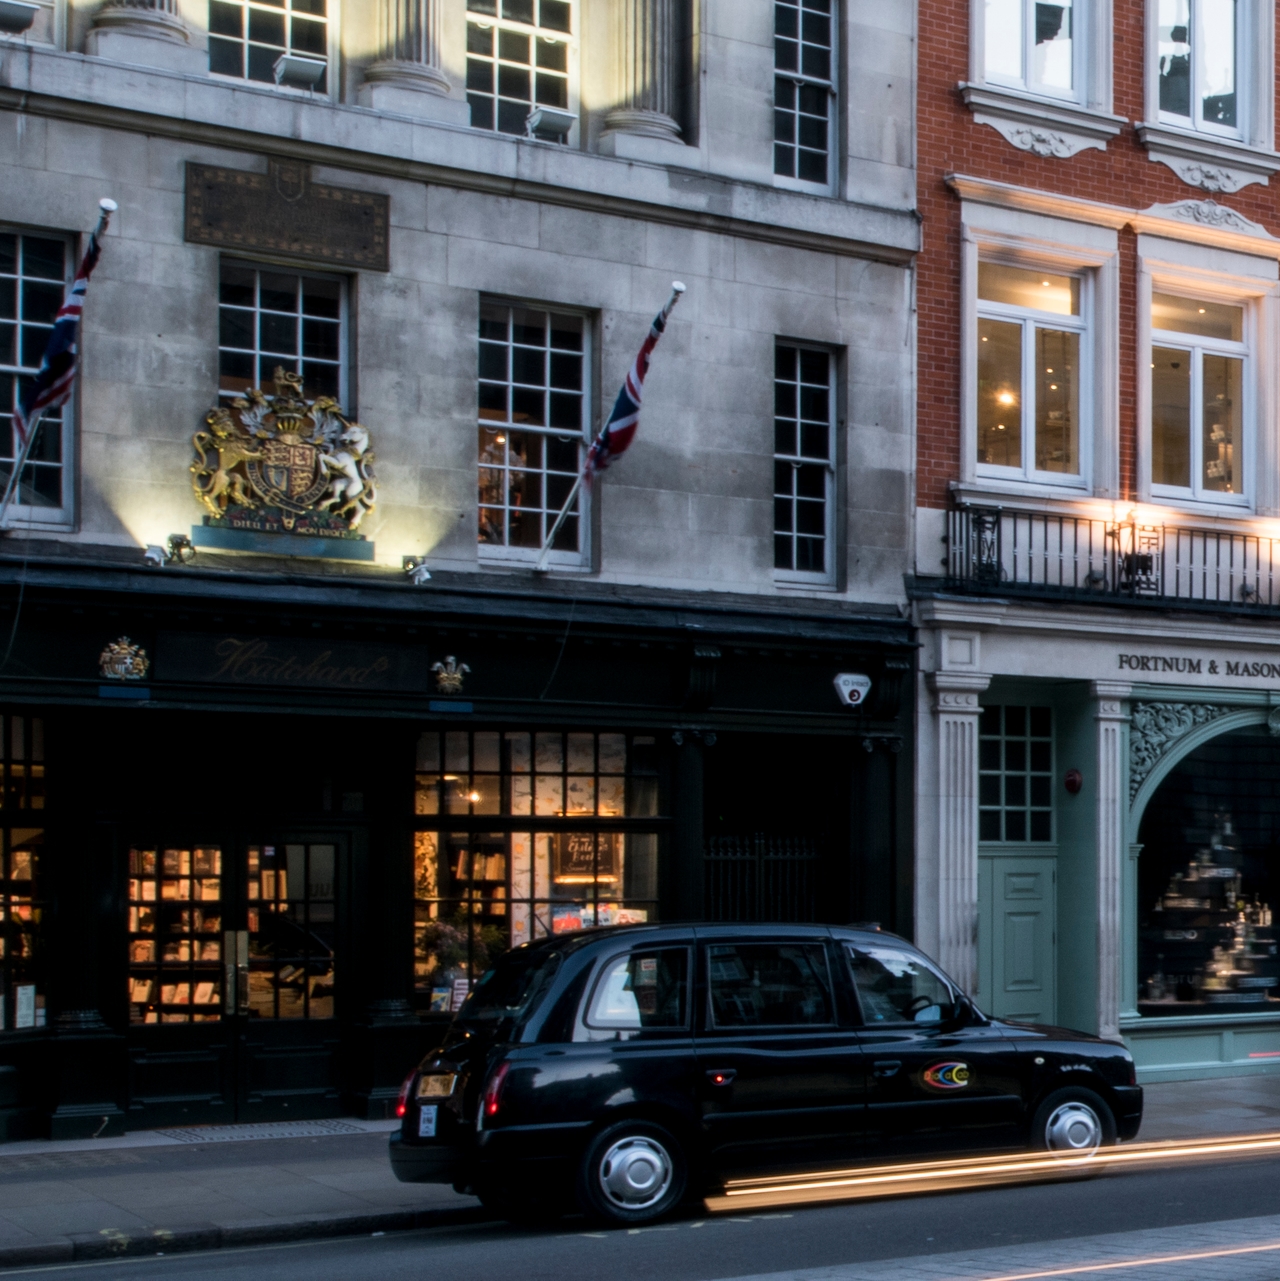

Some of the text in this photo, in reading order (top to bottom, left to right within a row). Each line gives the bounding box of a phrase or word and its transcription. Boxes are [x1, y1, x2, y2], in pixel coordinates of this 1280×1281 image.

[233, 519, 261, 530] DIEU
[265, 522, 279, 530] ET
[296, 526, 317, 535] MON
[1118, 654, 1202, 674] FORTNUM
[1208, 659, 1219, 675] &
